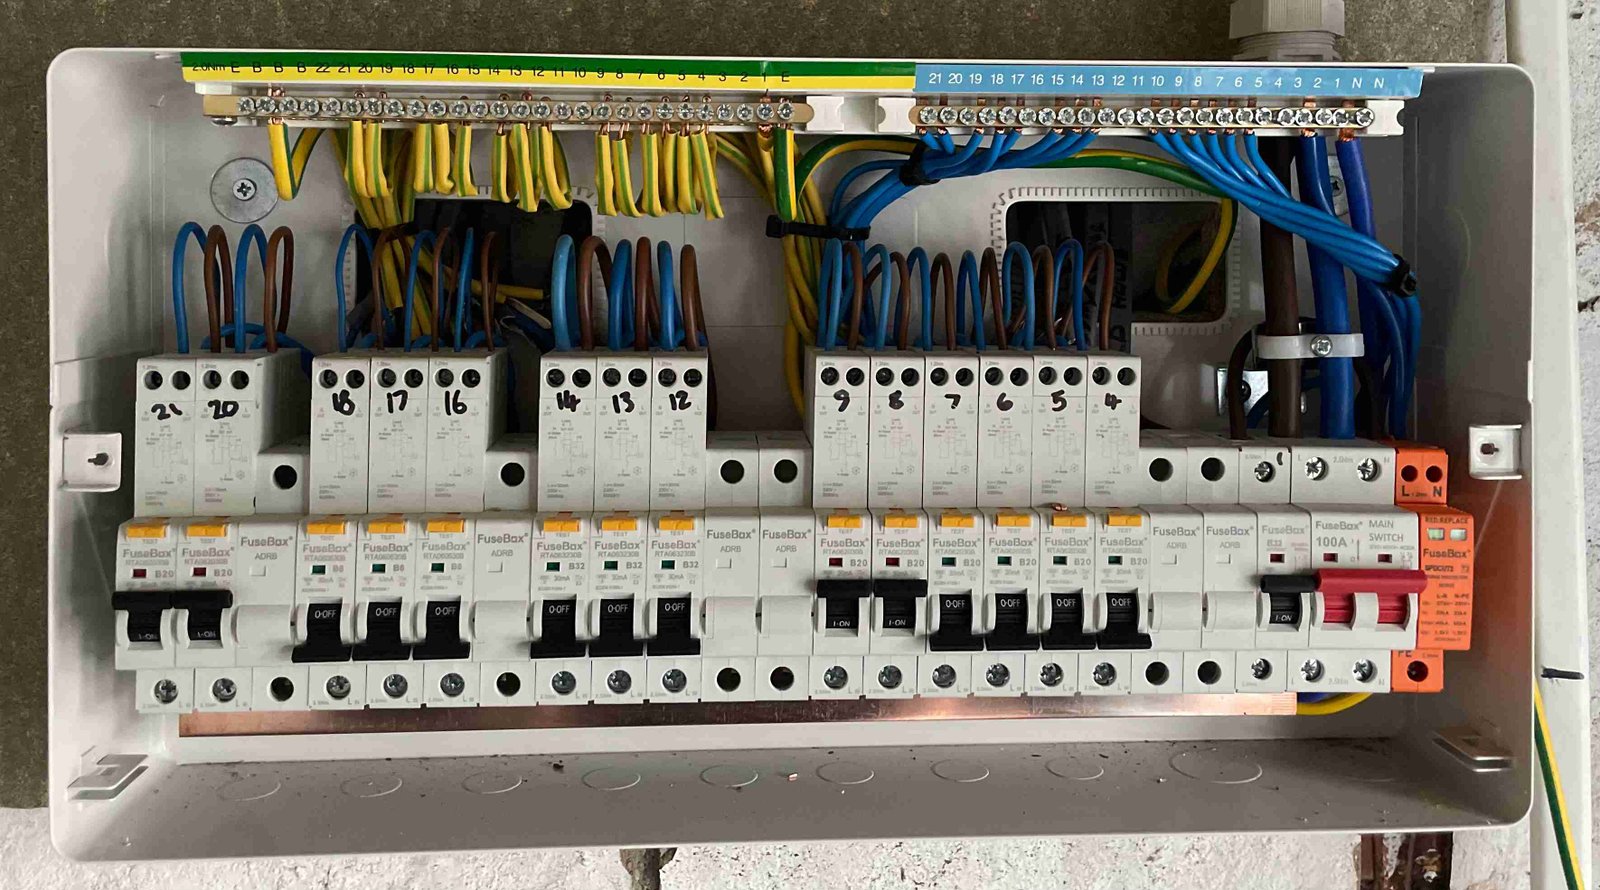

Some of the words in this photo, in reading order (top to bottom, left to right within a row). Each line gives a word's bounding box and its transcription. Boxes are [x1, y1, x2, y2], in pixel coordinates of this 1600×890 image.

[192, 62, 226, 72] 2.0Nm
[231, 62, 240, 73] E
[253, 62, 262, 73] B
[274, 62, 284, 73] B
[297, 62, 307, 73] B
[315, 63, 330, 73] 22
[338, 63, 350, 73] 21
[358, 63, 372, 73] 20
[380, 64, 393, 74] 19
[402, 64, 415, 74] 18
[424, 64, 435, 74] 17
[446, 65, 459, 75] 16
[468, 65, 480, 75] 15
[488, 65, 500, 75] 14
[509, 66, 522, 76] 13
[531, 66, 544, 77] 12
[553, 67, 564, 77] 11
[573, 67, 587, 78] 10
[597, 68, 605, 78] 9
[615, 68, 623, 79] 8
[636, 69, 644, 79] 7
[657, 69, 666, 80] 6
[678, 70, 686, 81] 5
[698, 70, 706, 81] 4
[719, 71, 727, 82] 3
[740, 71, 748, 82] 2
[762, 71, 767, 82] 1
[781, 72, 790, 82] E
[928, 73, 942, 84] 21
[948, 73, 962, 84] 20
[969, 73, 982, 84] 19
[991, 73, 1004, 84] 18
[1011, 74, 1025, 85] 17
[1031, 74, 1044, 85] 16
[1051, 74, 1064, 85] 15
[1071, 74, 1084, 85] 14
[1091, 74, 1105, 86] 13
[1112, 75, 1125, 86] 12
[1132, 75, 1144, 87] 11
[1152, 75, 1164, 87] 10
[1175, 76, 1183, 87] 9
[1194, 76, 1202, 87] 8
[1215, 76, 1224, 87] 7
[1234, 76, 1243, 88] 6
[1254, 77, 1263, 88] 5
[1274, 77, 1282, 88] 4
[1294, 77, 1302, 88] 3
[1313, 77, 1322, 88] 2
[1335, 78, 1340, 88] 1
[1352, 78, 1362, 89] N
[1373, 78, 1385, 89] N
[386, 390, 408, 414] 17
[444, 390, 468, 416] 16
[556, 390, 581, 412] 14
[612, 391, 635, 414] 13
[668, 390, 692, 411] 12
[833, 389, 851, 413] 9
[888, 389, 905, 410] 8
[944, 393, 961, 410] 7
[996, 392, 1014, 412] 6
[1051, 389, 1068, 412] 5
[1104, 392, 1122, 411] 4
[207, 399, 239, 420] 20
[1401, 485, 1410, 497] L
[1433, 486, 1442, 497] N
[1315, 521, 1359, 530] FuseBox
[1369, 520, 1394, 528] MAIN
[706, 530, 752, 539] FuseBox
[762, 529, 808, 539] FuseBox
[1153, 527, 1196, 537] FuseBox
[1206, 526, 1250, 536] FuseBox
[1262, 525, 1305, 534] FuseBox
[240, 537, 288, 547] FuseBox
[477, 533, 524, 544] FuseBox
[933, 538, 978, 547] FuseBox
[989, 537, 1033, 547] FuseBox
[1044, 537, 1089, 546] FuseBox
[1100, 537, 1145, 546] FuseBox
[1316, 536, 1348, 547] 100A
[1369, 533, 1404, 542] SWITCH
[363, 543, 409, 553] FuseBox
[422, 542, 467, 551] FuseBox
[536, 542, 583, 551] FuseBox
[594, 541, 640, 550] FuseBox
[651, 540, 697, 549] FuseBox
[820, 538, 866, 548] FuseBox
[876, 538, 921, 548] FuseBox
[122, 548, 172, 558] FuseBox
[182, 547, 231, 557] FuseBox
[302, 544, 348, 553] FuseBox
[1423, 549, 1467, 558] FuseBox
[568, 562, 585, 570] B32
[626, 561, 643, 569] B32
[850, 559, 868, 567] B20
[907, 559, 925, 567] B20
[963, 559, 981, 567] B20
[1019, 558, 1037, 566] B20
[1074, 558, 1092, 566] B20
[1130, 557, 1148, 565] B20
[155, 570, 174, 578] B20
[214, 568, 233, 577] B20
